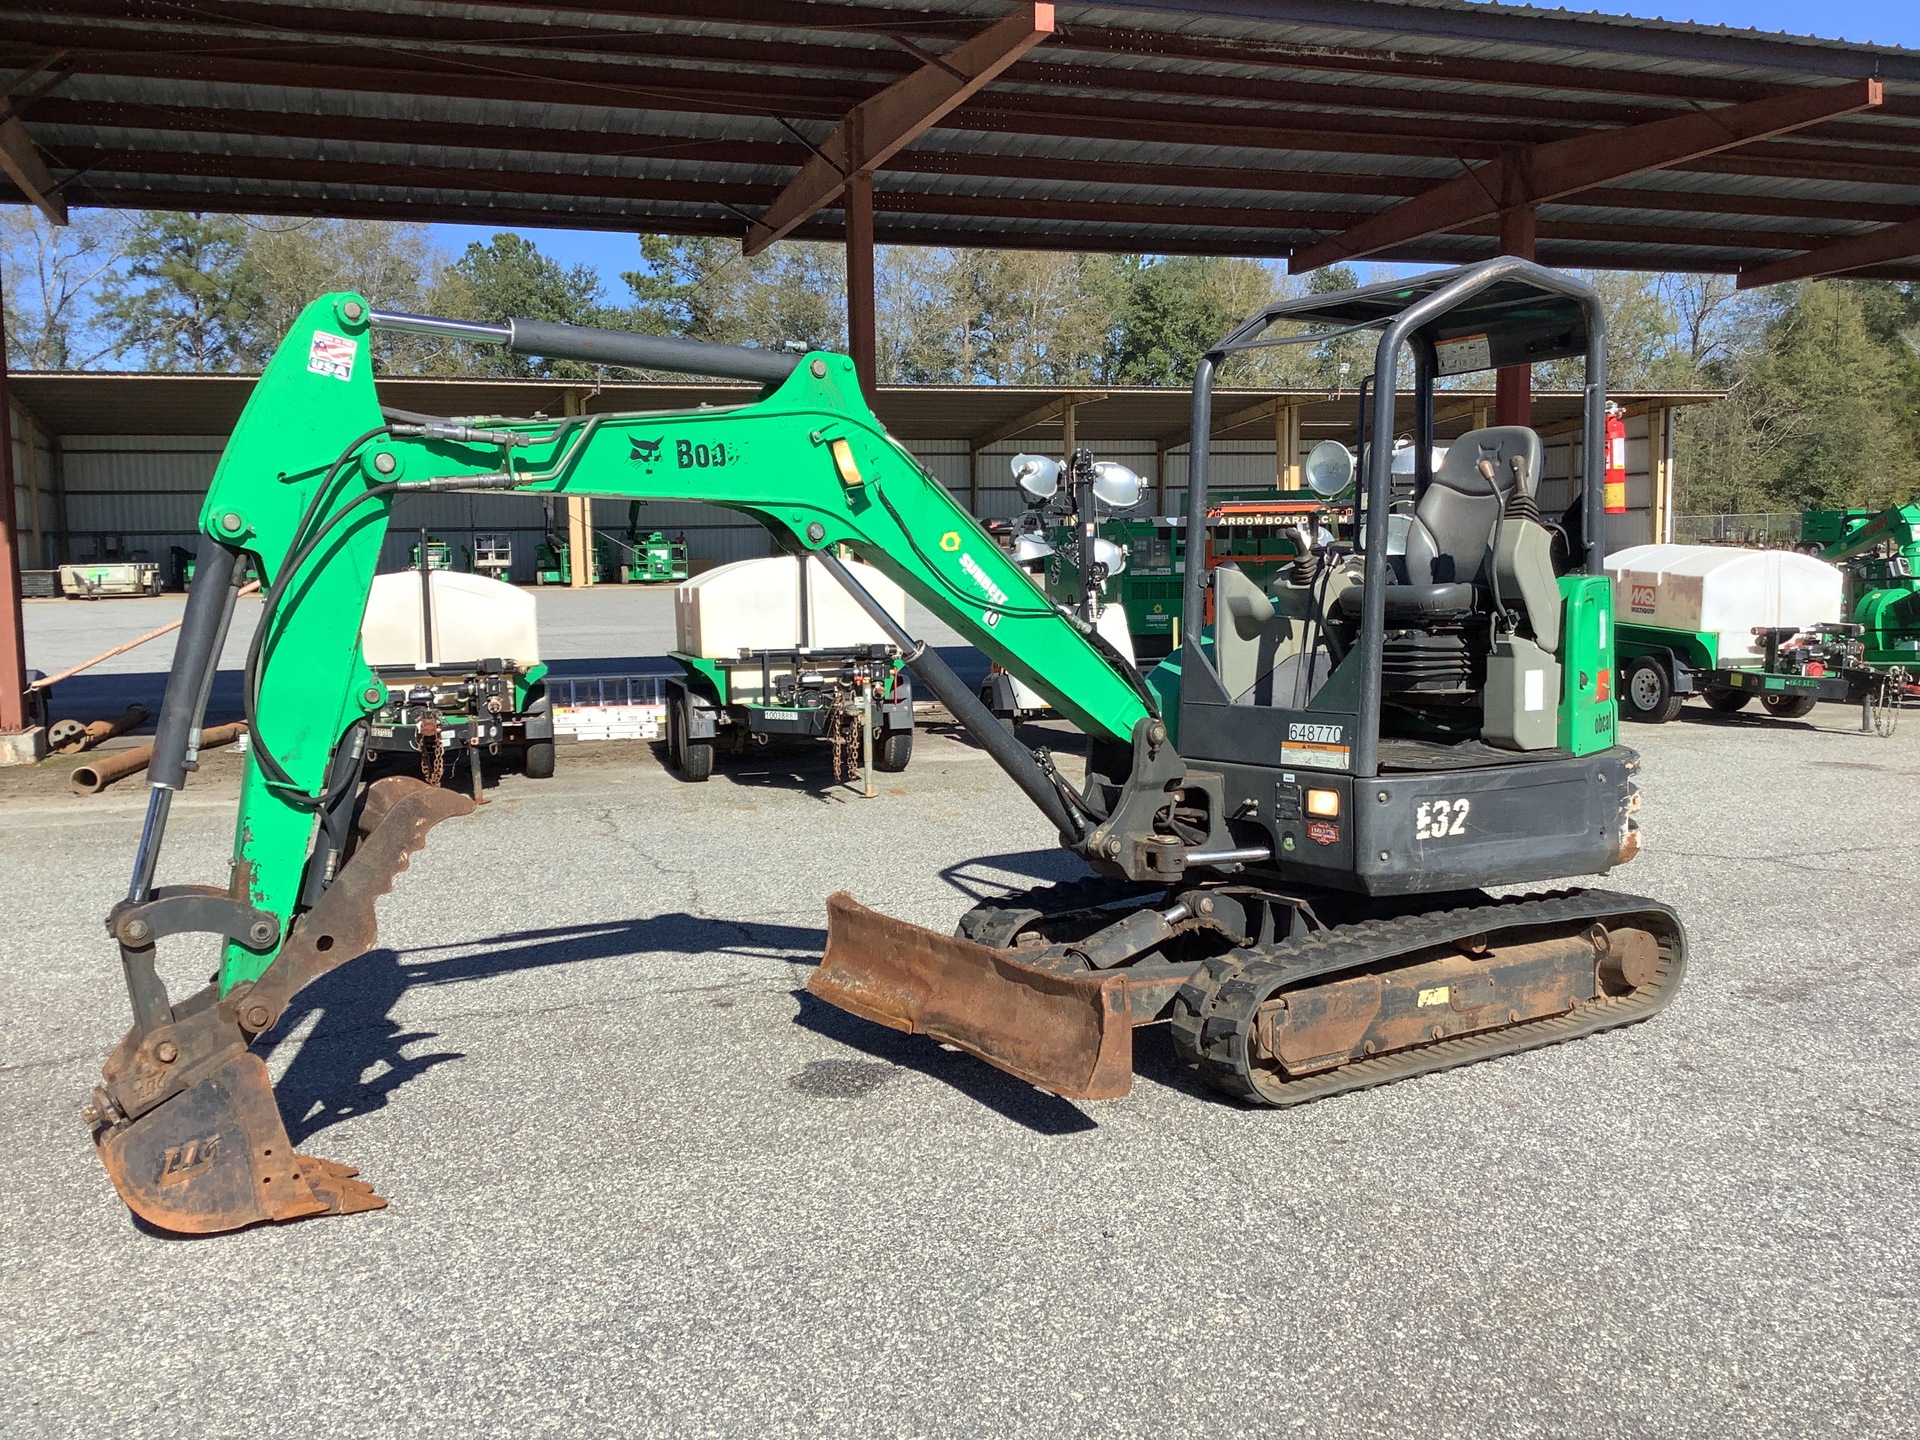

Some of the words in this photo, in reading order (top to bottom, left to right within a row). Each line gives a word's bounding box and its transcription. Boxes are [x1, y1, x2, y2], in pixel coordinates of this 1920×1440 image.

[310, 357, 350, 378] USA
[959, 552, 1009, 605] SUNBELT
[1630, 606, 1656, 615] MULTIQUIP
[1290, 724, 1342, 743] 648770
[1416, 798, 1470, 840] E32
